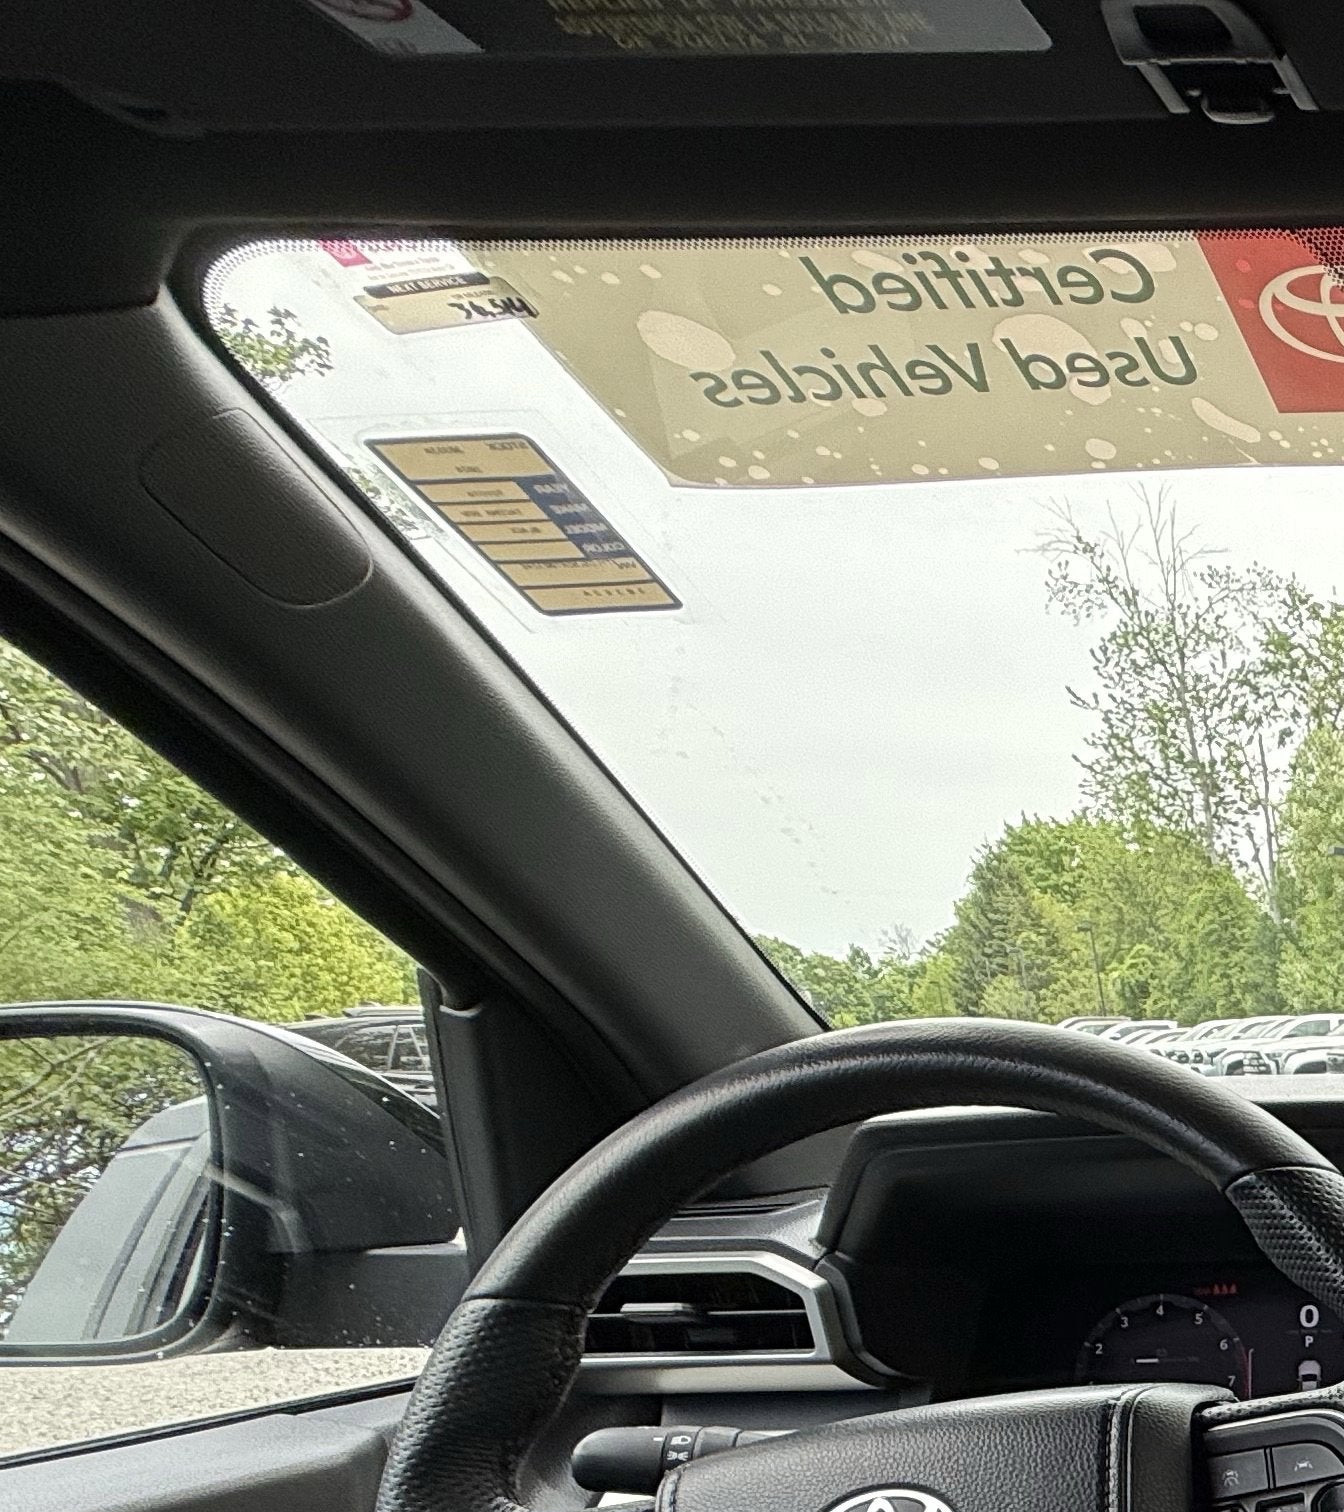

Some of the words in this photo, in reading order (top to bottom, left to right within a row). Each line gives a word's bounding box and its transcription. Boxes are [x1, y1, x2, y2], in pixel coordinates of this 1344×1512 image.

[1156, 1304, 1165, 1316] 4
[1299, 1304, 1320, 1328] 0
[1120, 1316, 1129, 1328] 3
[1194, 1313, 1203, 1325] 5
[1219, 1339, 1228, 1351] 6
[1305, 1335, 1314, 1347] P
[1095, 1344, 1103, 1355] 2
[1228, 1375, 1236, 1386] 7
